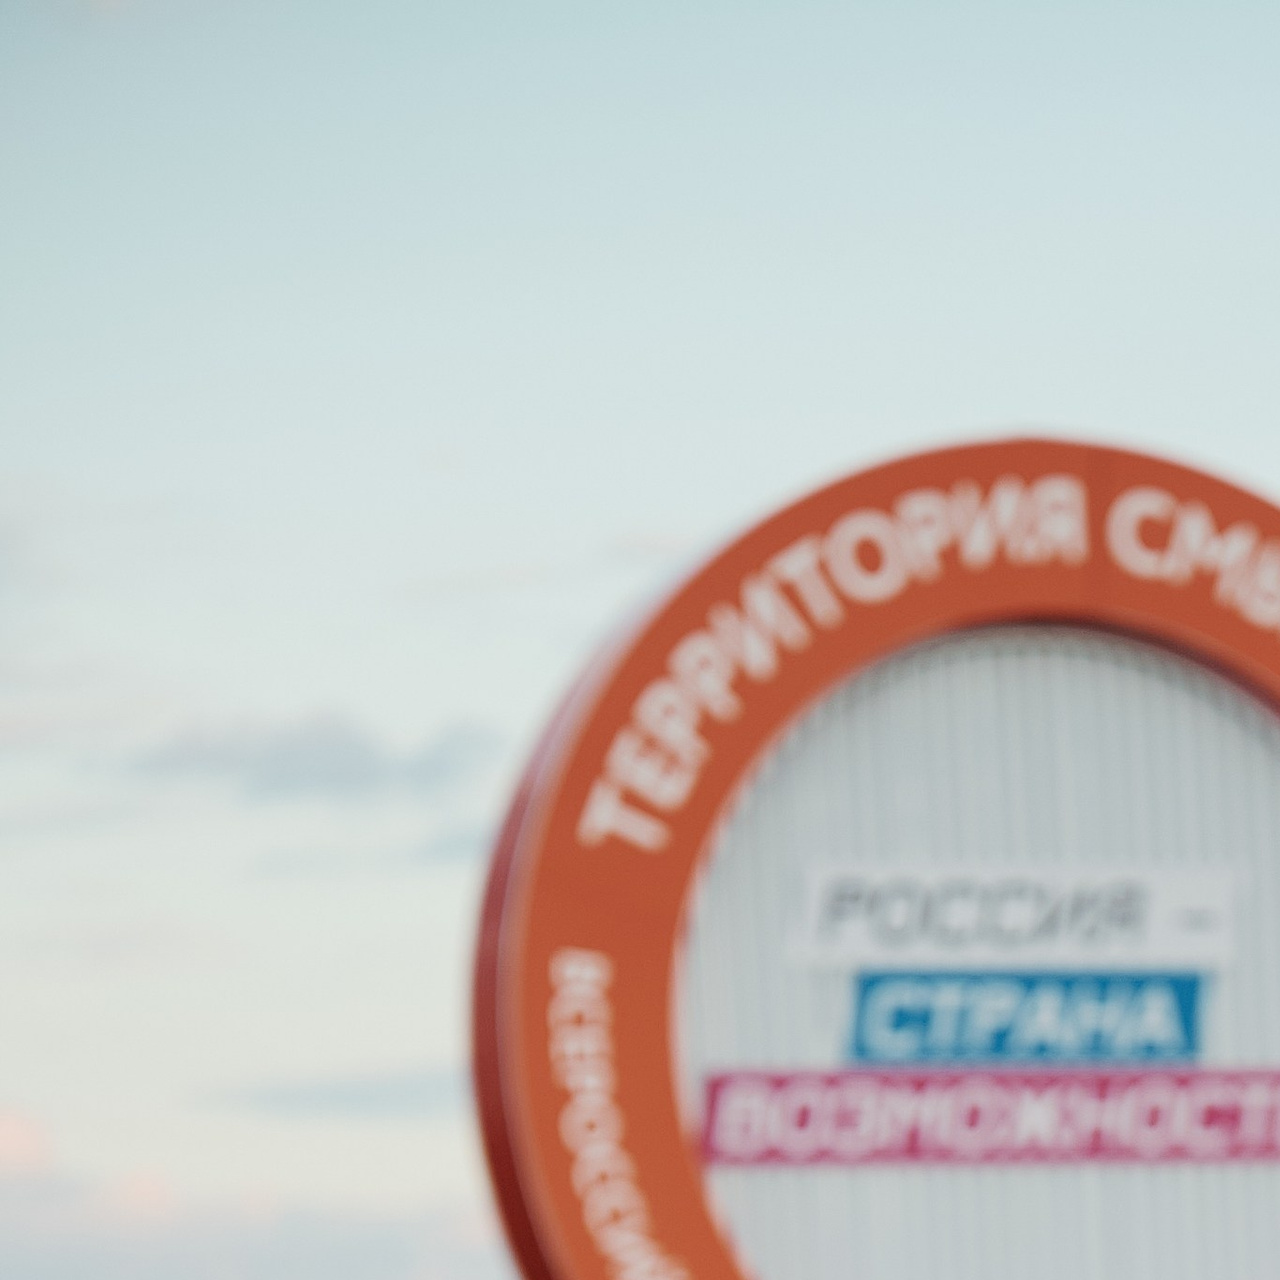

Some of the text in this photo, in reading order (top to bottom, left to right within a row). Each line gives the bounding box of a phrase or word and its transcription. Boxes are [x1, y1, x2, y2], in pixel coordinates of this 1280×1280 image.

[578, 474, 1090, 853] ТЕРРИТОРИЯ
[816, 875, 1151, 948] РОССИЯ
[855, 976, 1186, 1058] СТРАНА
